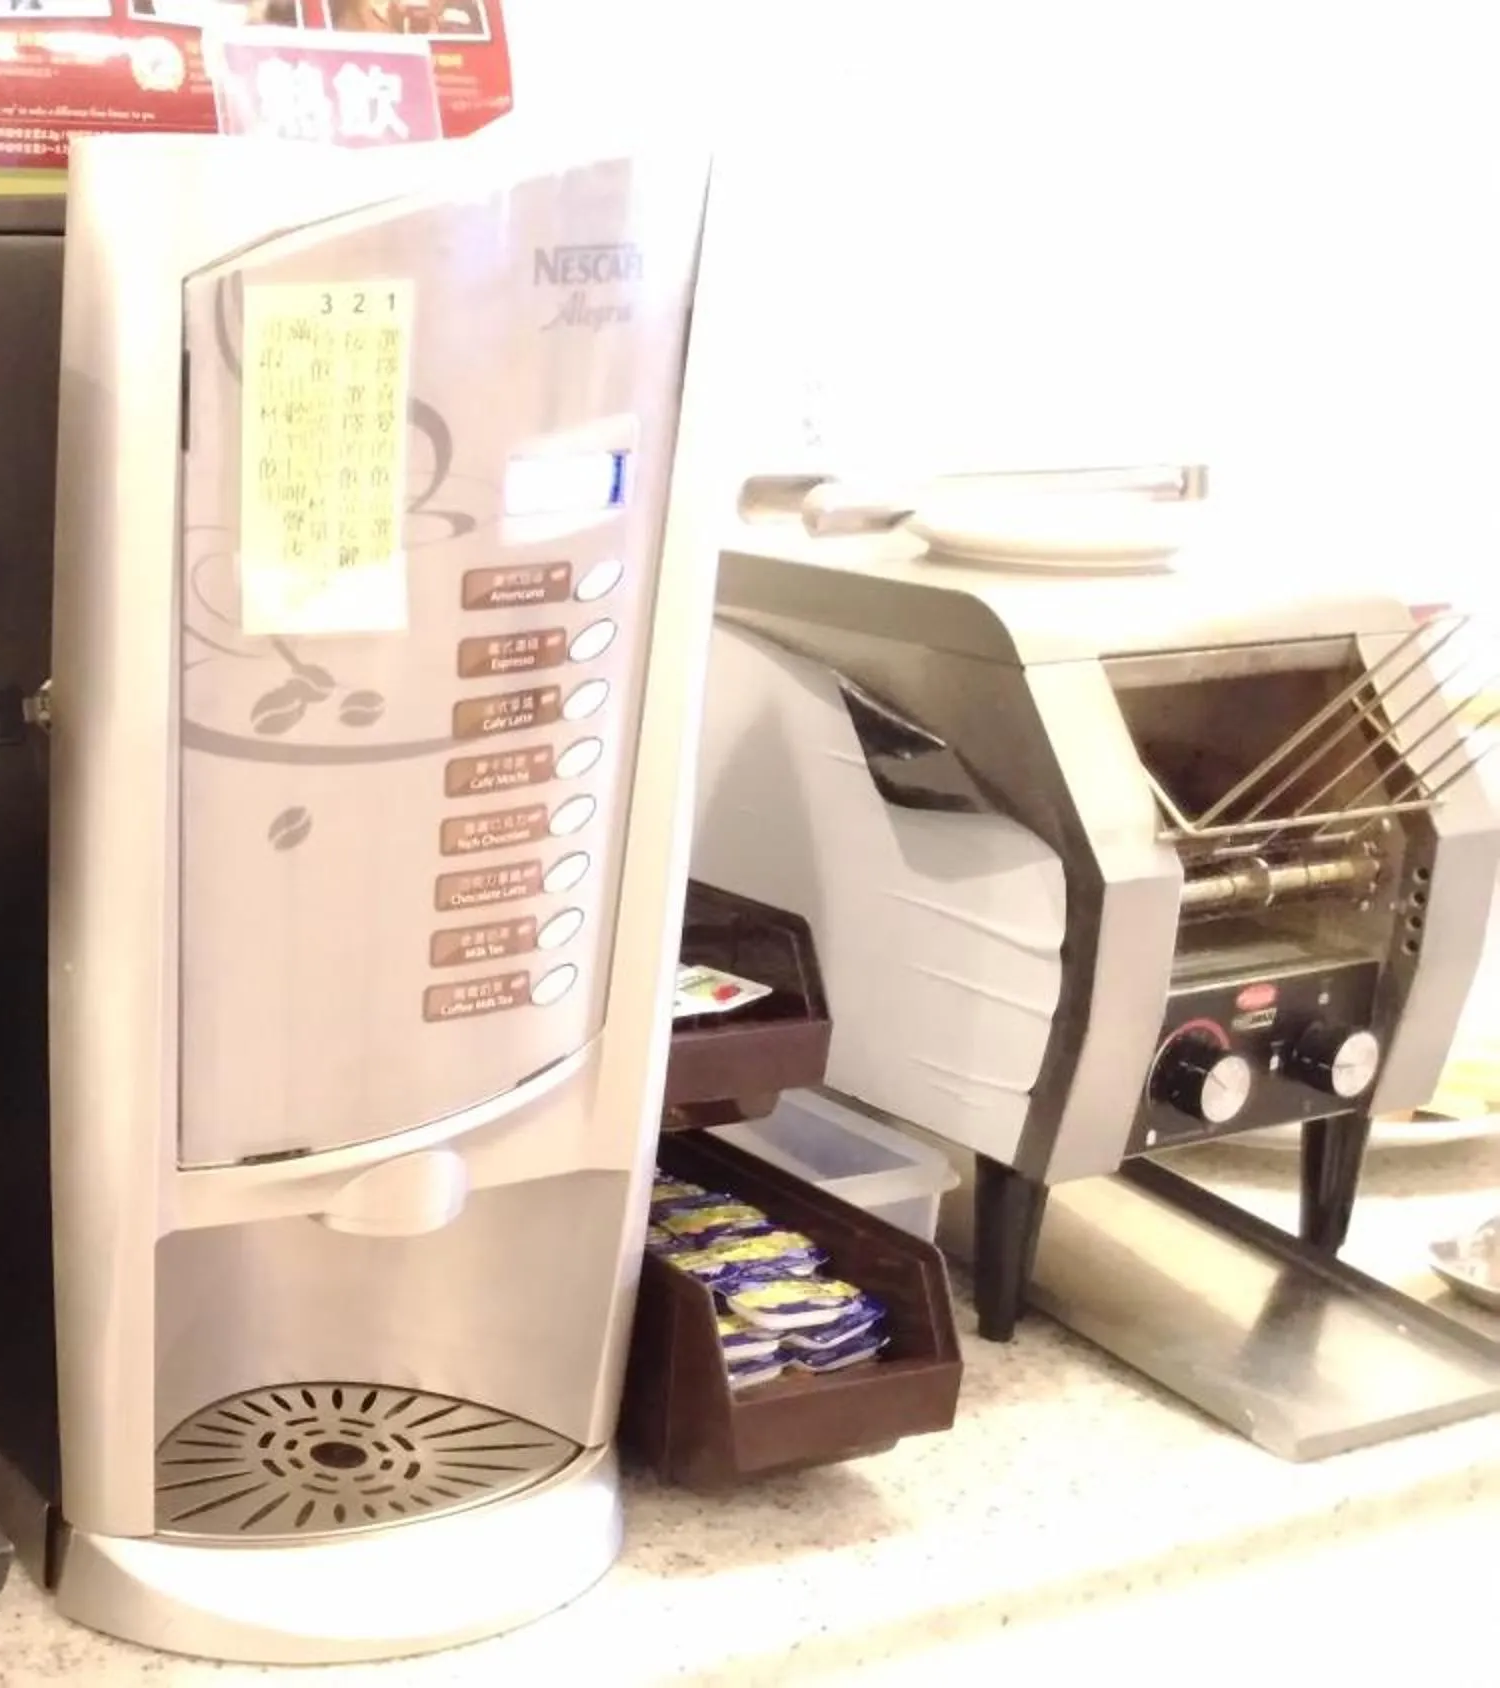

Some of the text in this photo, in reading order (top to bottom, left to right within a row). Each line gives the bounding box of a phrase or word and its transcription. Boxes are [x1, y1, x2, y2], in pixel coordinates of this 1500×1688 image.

[320, 292, 396, 315] 3 2 1
